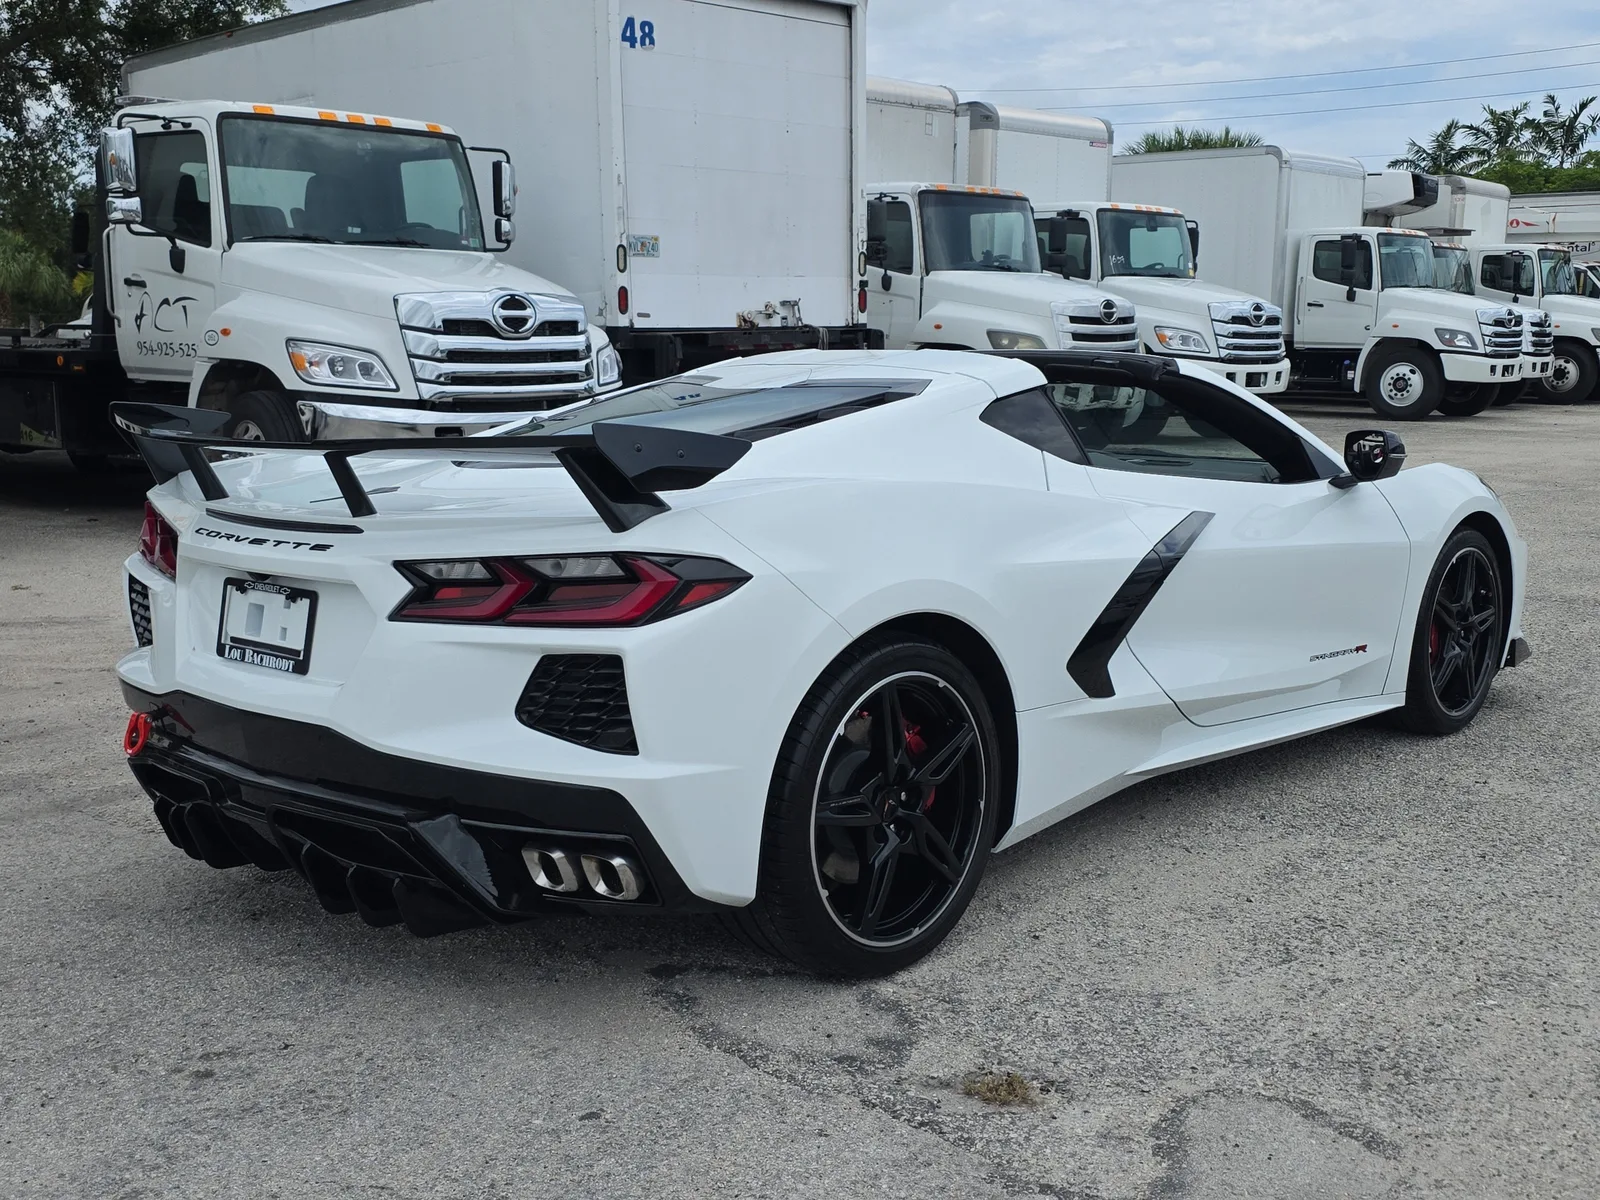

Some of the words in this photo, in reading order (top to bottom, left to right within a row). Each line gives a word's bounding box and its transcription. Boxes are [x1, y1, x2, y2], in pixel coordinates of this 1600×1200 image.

[621, 16, 655, 50] 48
[195, 527, 334, 552] CORVETTE
[254, 582, 280, 593] CHEVROLET
